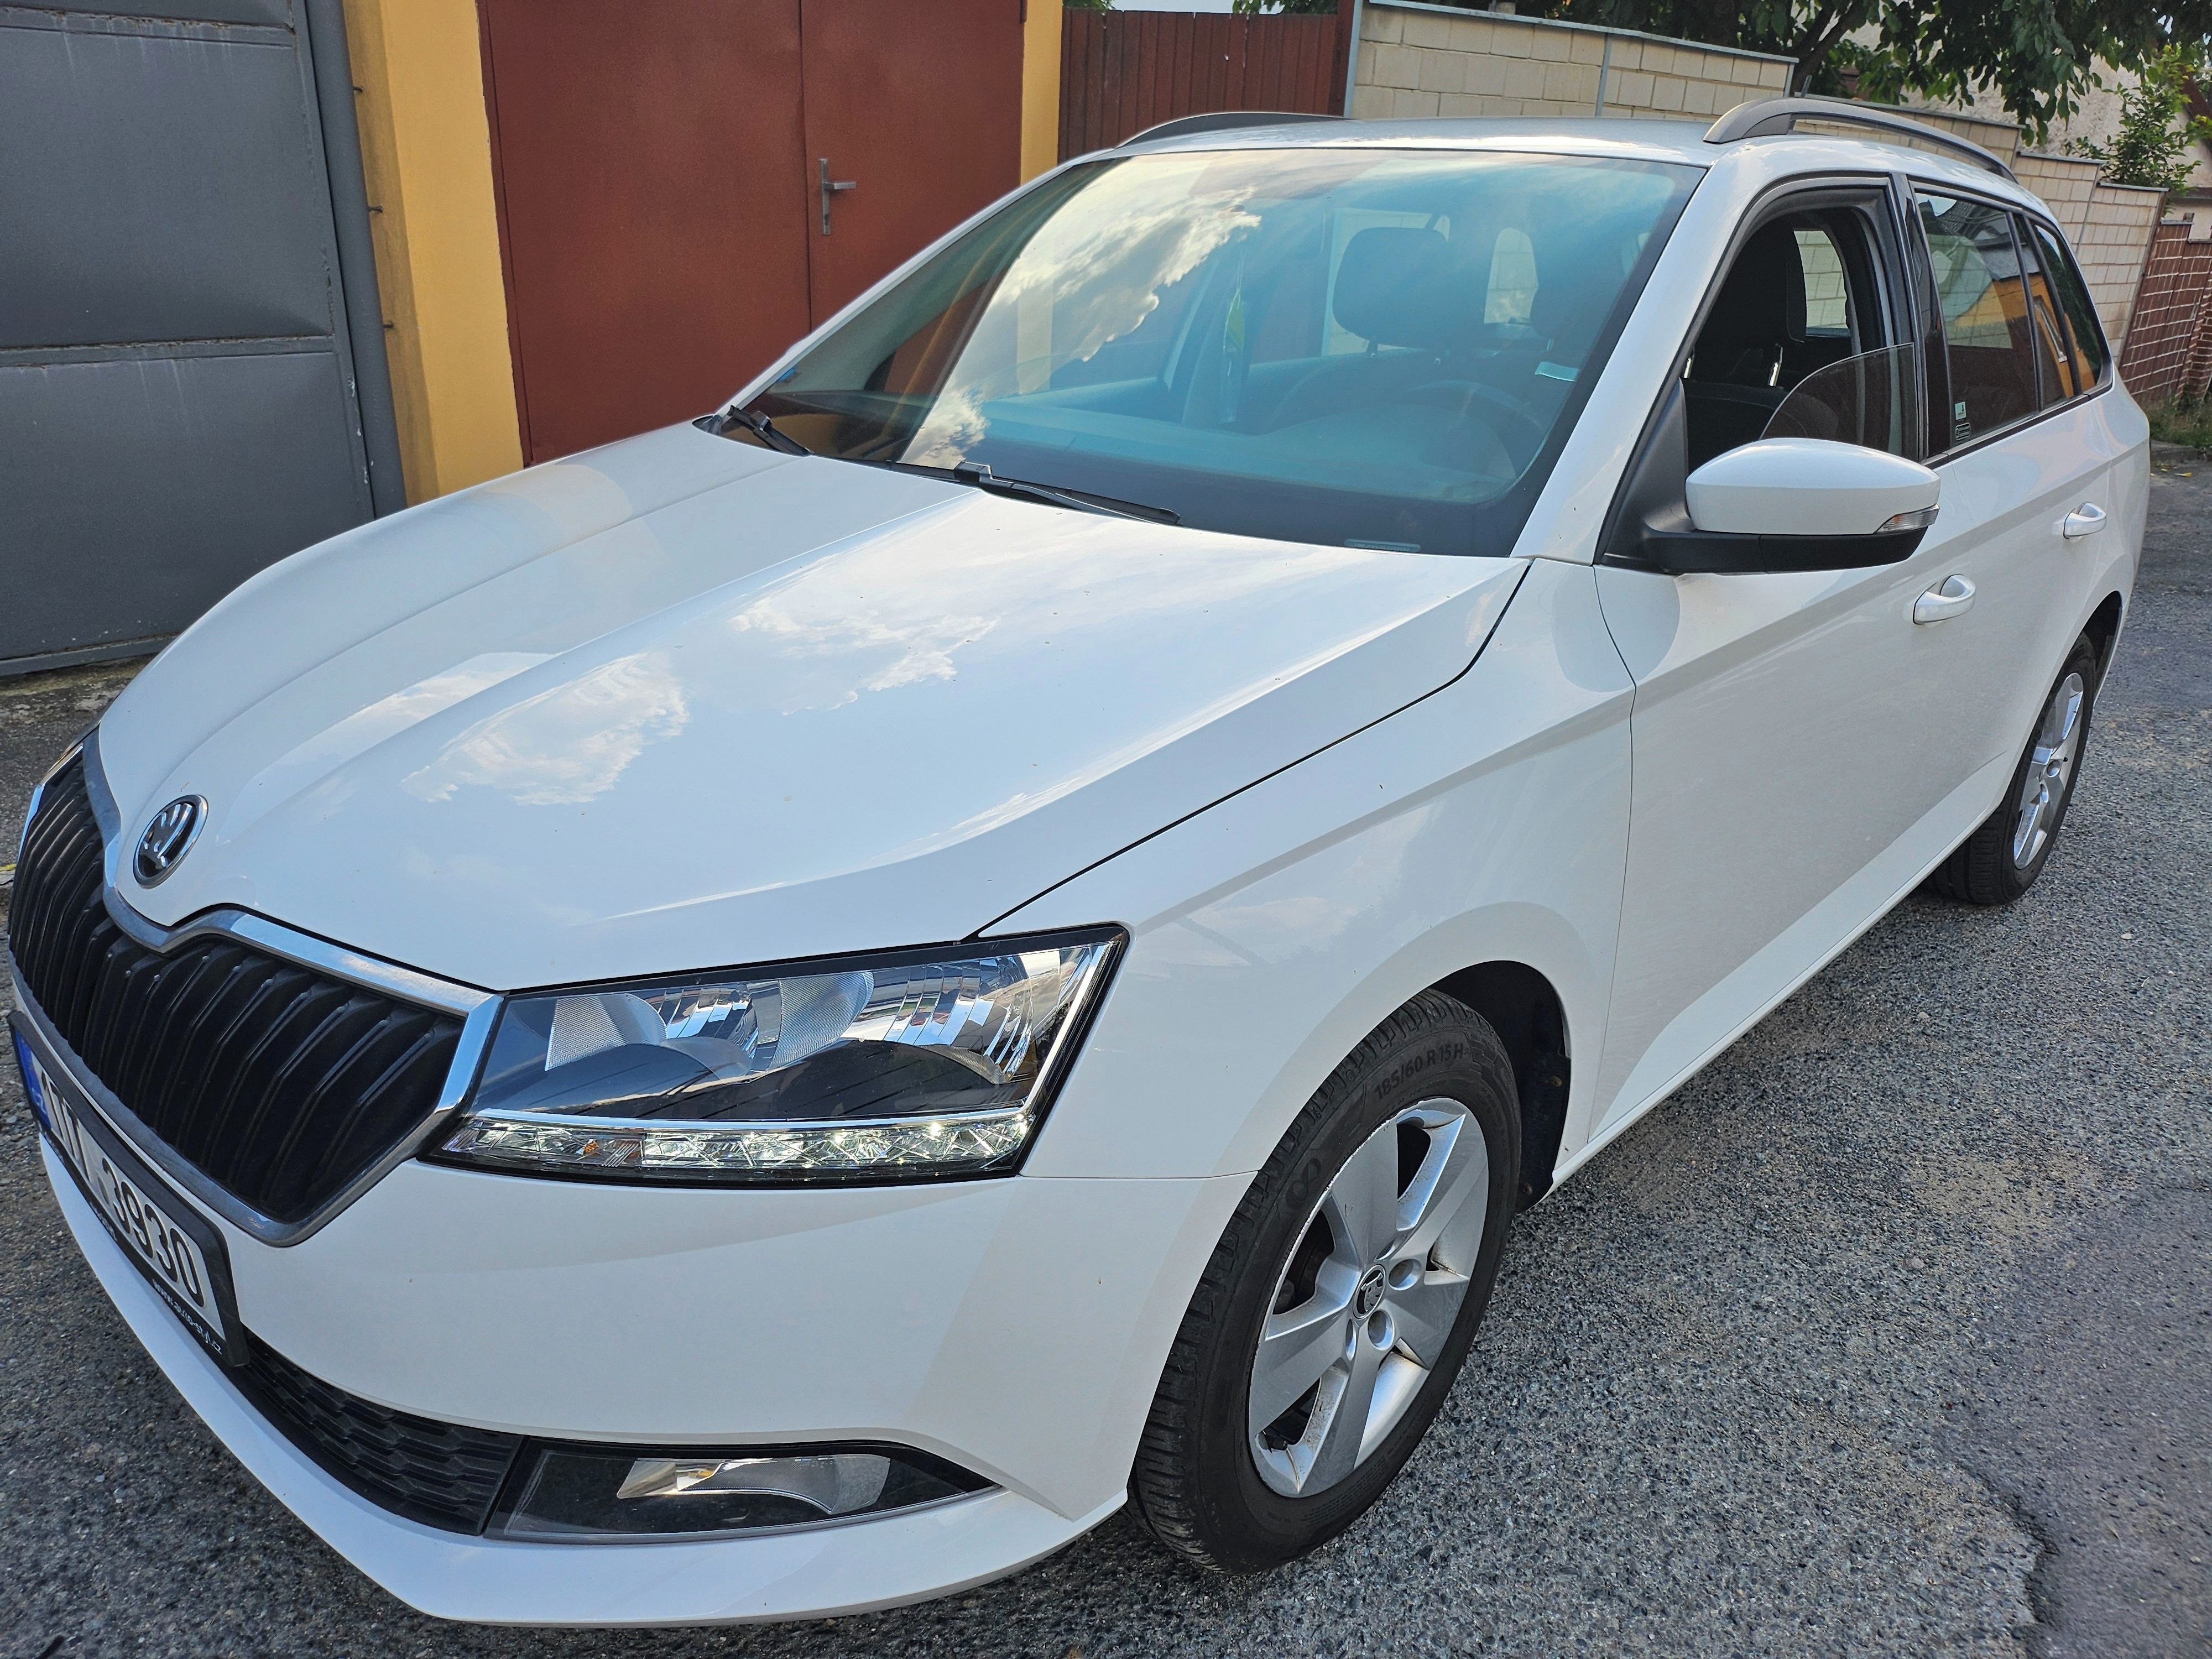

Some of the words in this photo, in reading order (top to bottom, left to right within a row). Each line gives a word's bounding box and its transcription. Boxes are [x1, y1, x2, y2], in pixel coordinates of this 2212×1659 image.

[1374, 1056, 1423, 1099] 185/60
[1427, 1048, 1436, 1067] R
[1439, 1044, 1452, 1062] 15
[1454, 1043, 1464, 1060] H
[41, 1070, 90, 1182] 1TT
[102, 1156, 205, 1308] 3930
